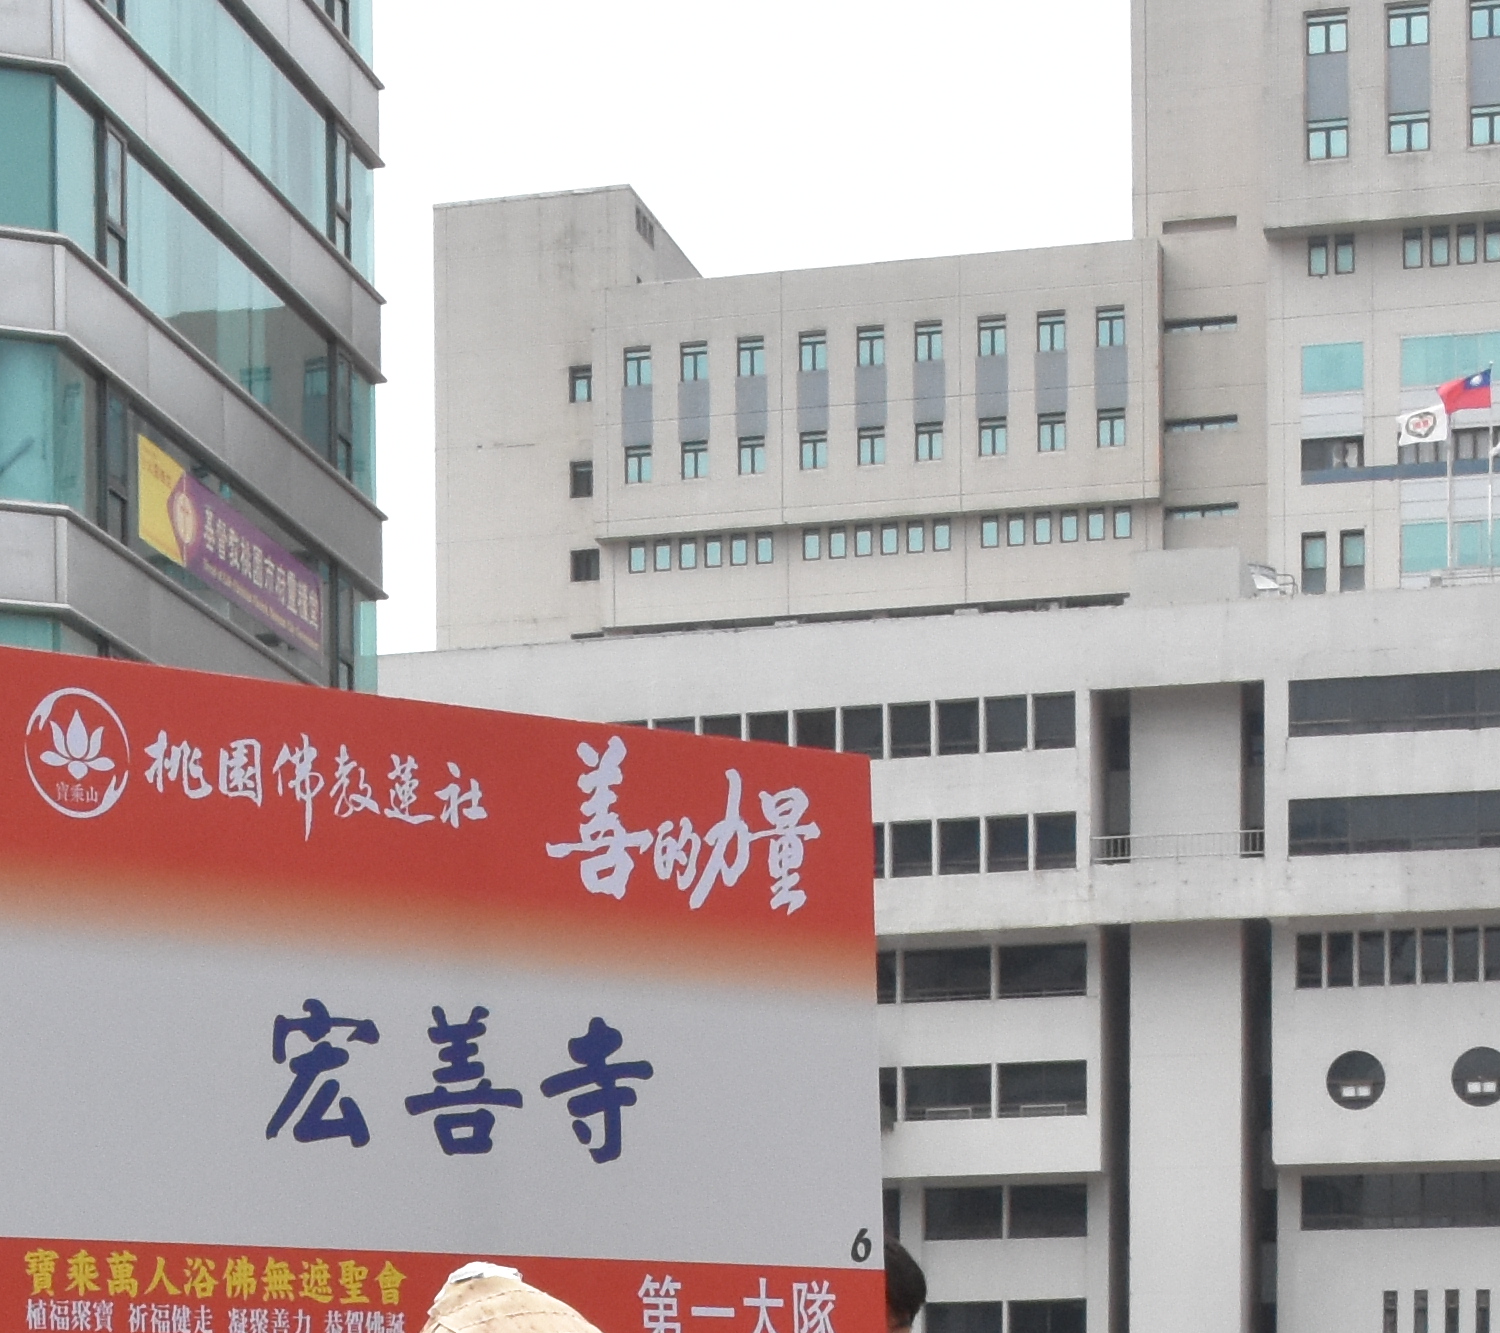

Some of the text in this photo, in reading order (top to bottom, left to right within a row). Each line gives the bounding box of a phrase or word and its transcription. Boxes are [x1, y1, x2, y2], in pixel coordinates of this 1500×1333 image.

[144, 728, 489, 842] 桃園佛教蓮社
[545, 736, 822, 915] 善的力量
[265, 998, 655, 1165] 宏善寺
[24, 1247, 408, 1307] 寶乘萬人浴佛無遮聖會
[849, 1226, 873, 1264] 6
[26, 1298, 115, 1333] 植福聚寶
